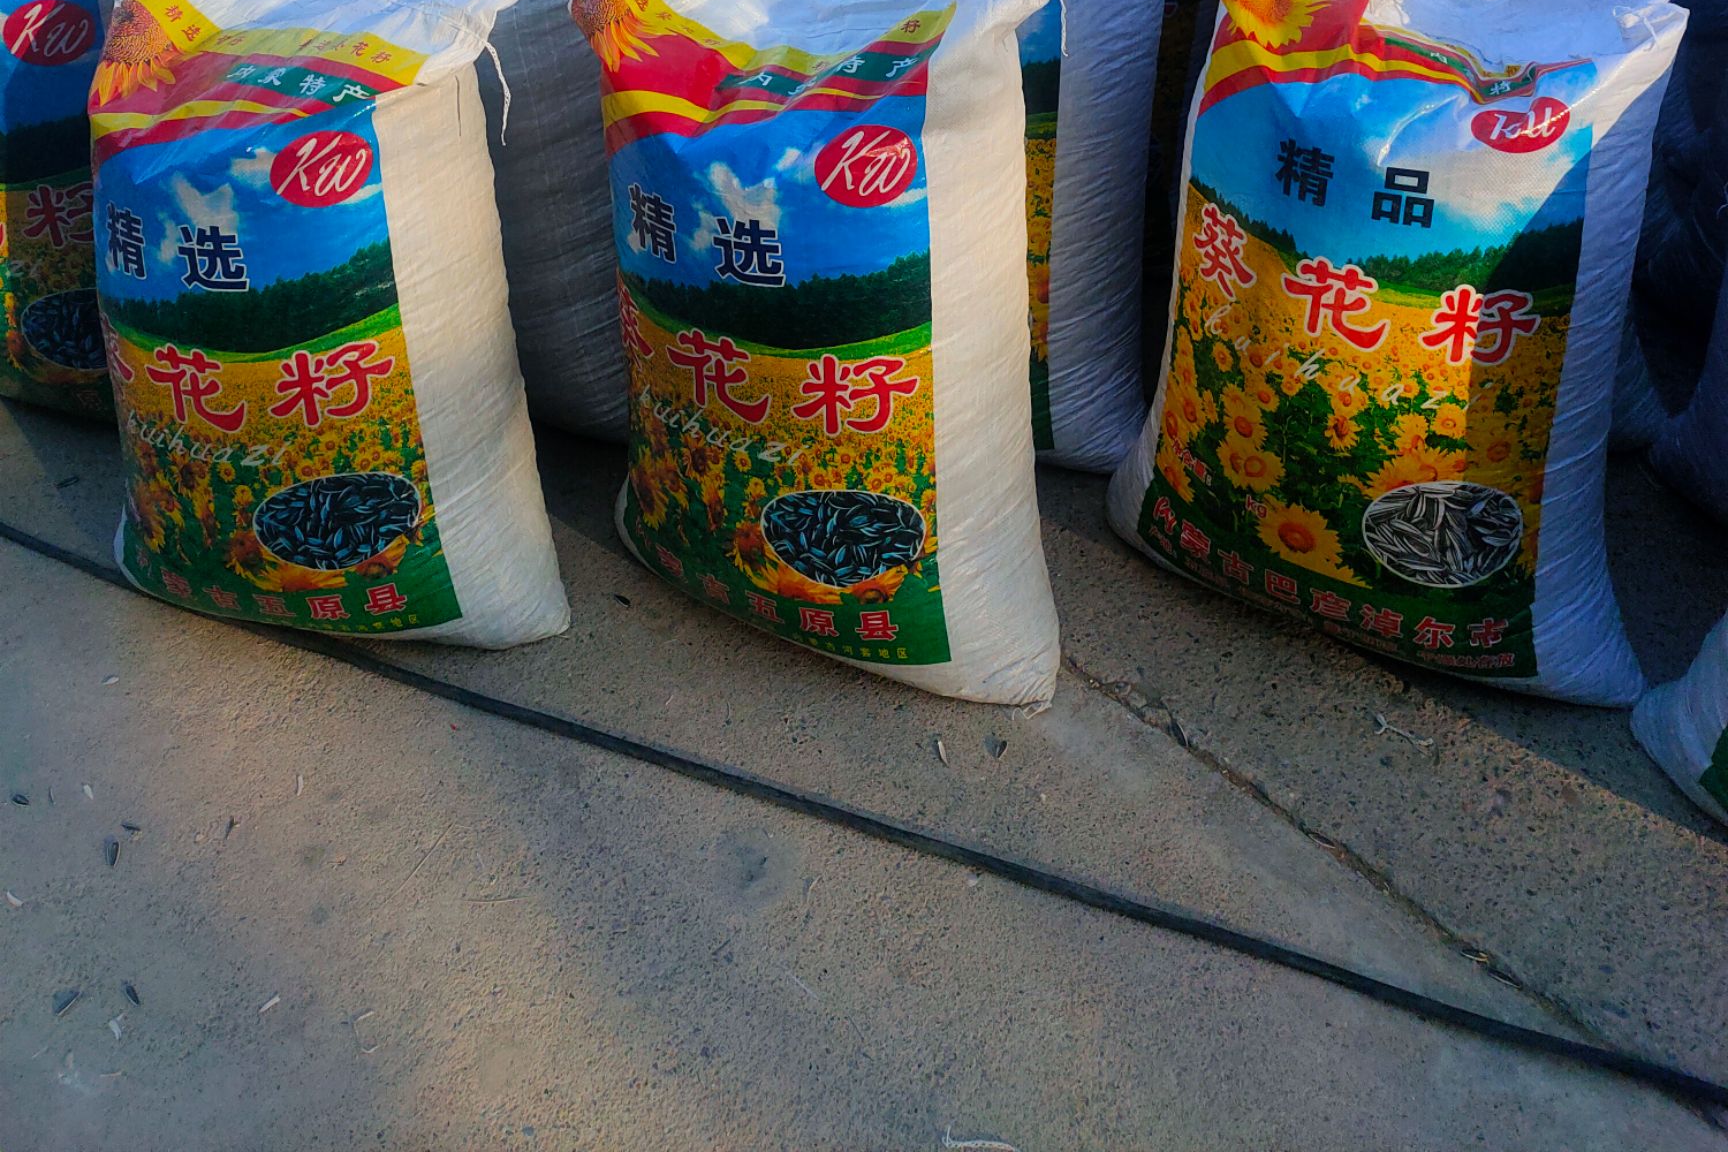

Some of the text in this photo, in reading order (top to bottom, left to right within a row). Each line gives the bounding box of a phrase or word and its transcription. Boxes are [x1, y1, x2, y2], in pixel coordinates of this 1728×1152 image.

[1275, 137, 1435, 229] 精品
[105, 200, 250, 293] 精选
[629, 182, 785, 288] 精选
[1193, 202, 1542, 367] 葵花籽
